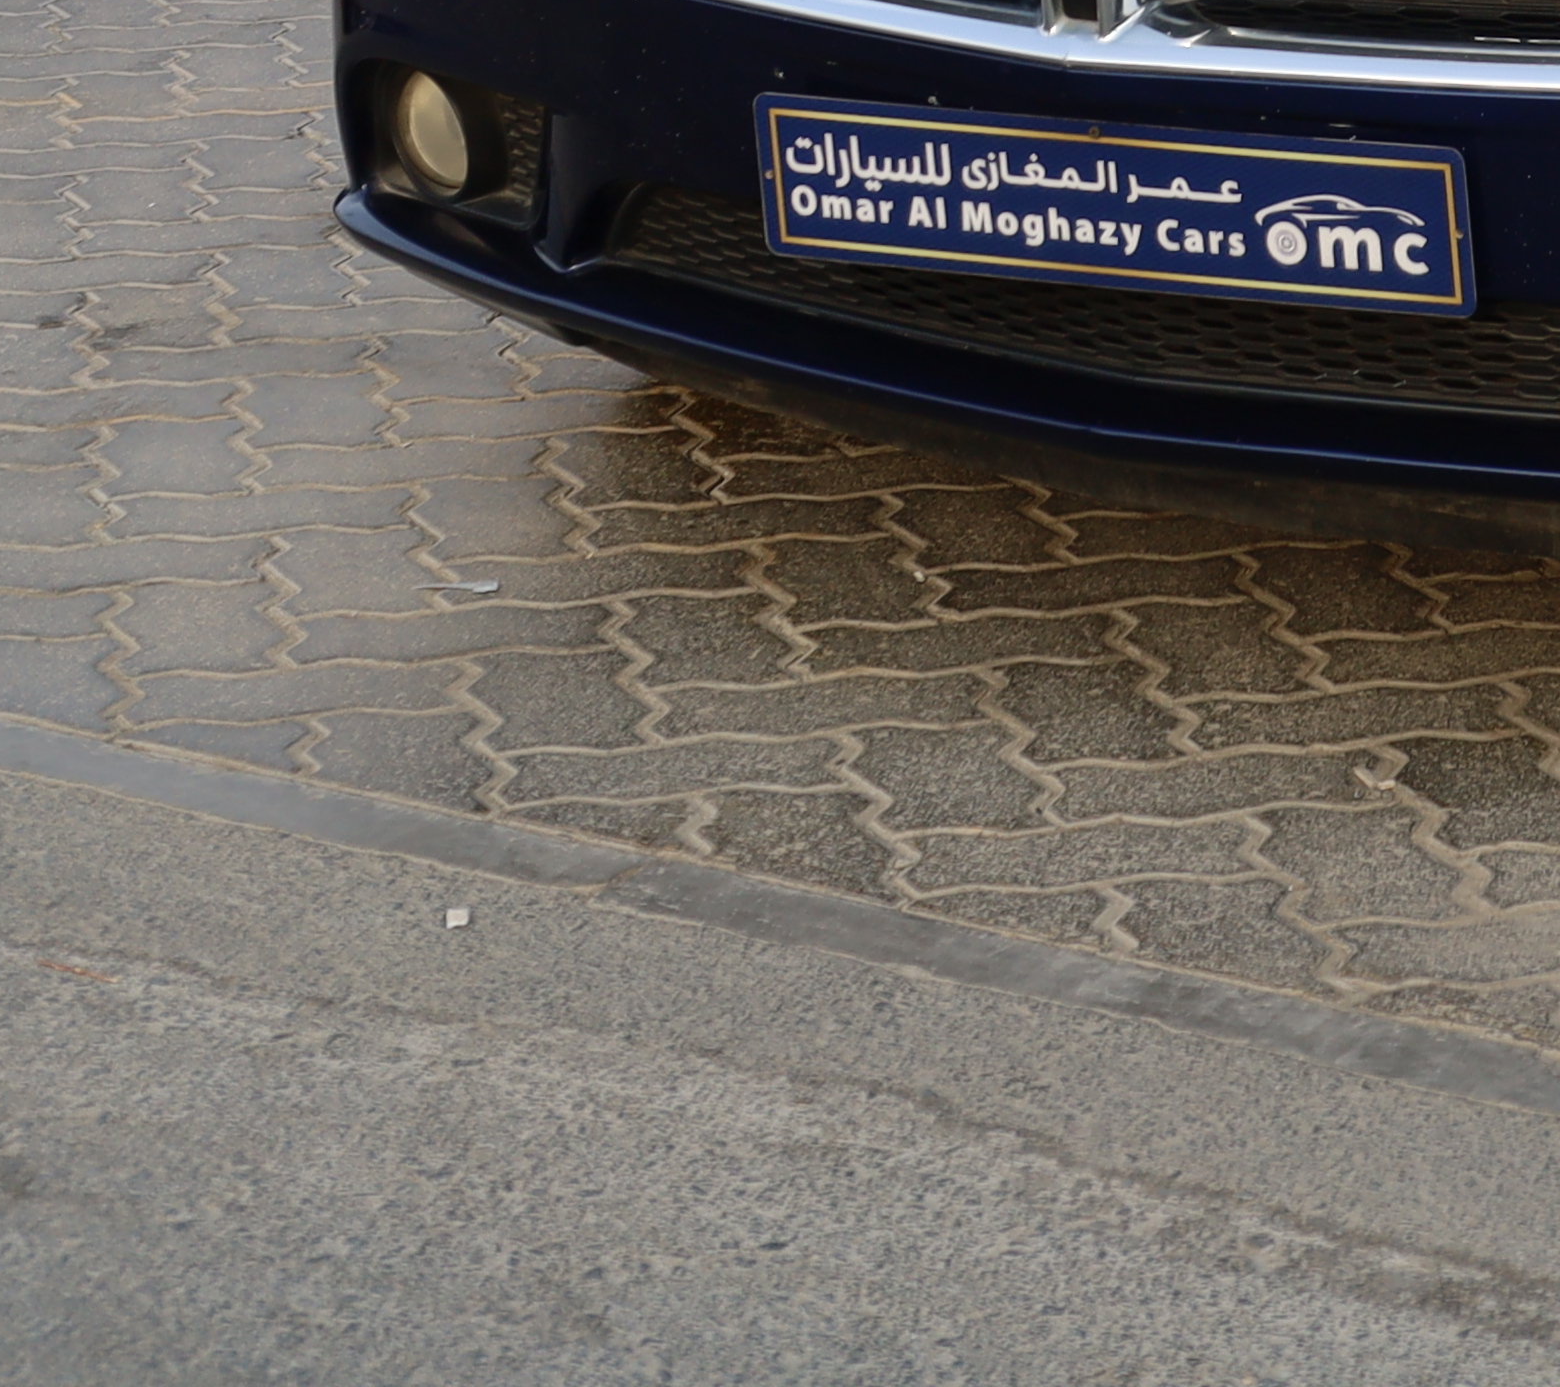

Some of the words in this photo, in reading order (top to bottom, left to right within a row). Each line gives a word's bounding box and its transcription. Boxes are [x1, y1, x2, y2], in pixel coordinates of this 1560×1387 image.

[785, 132, 953, 192] للسيارات
[1126, 173, 1243, 204] عمر
[790, 184, 895, 225] Omar
[907, 195, 948, 230] Al
[961, 200, 1143, 257] Moghazy
[1156, 218, 1247, 258] Cars
